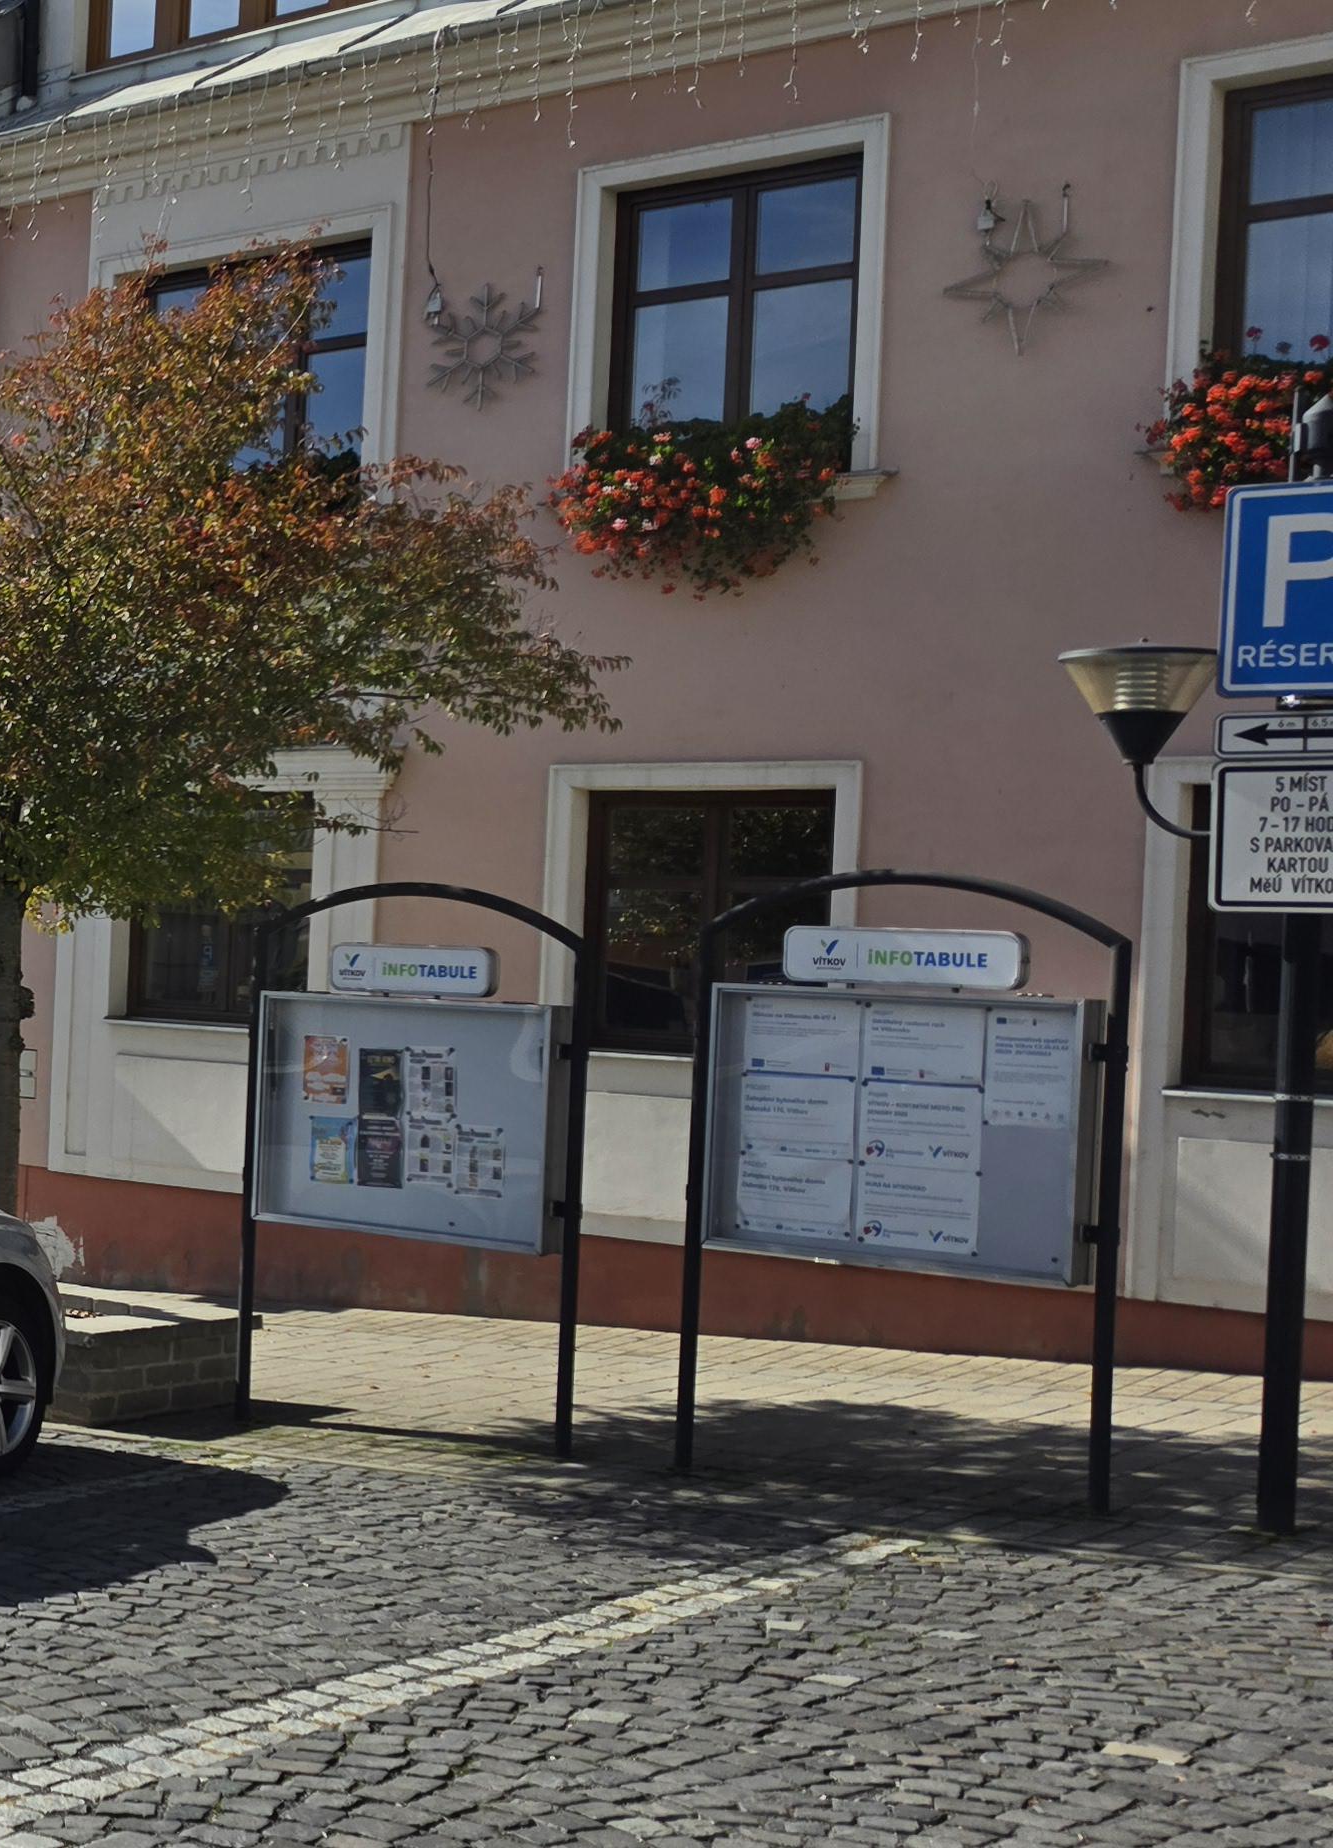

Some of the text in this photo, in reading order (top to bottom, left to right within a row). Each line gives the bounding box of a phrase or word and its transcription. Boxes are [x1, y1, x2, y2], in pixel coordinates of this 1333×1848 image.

[1262, 512, 1333, 628] P
[1275, 772, 1328, 793] 5 MÍST
[1270, 796, 1291, 813] PO
[1308, 792, 1330, 813] PÁ
[1259, 816, 1268, 833] 7
[1283, 816, 1300, 833] 17
[1249, 837, 1333, 853] S PARKOVA
[1266, 856, 1329, 874] KARTOU
[1249, 873, 1333, 894] MěÚ VÍTKO
[812, 956, 846, 967] VÍTKOV
